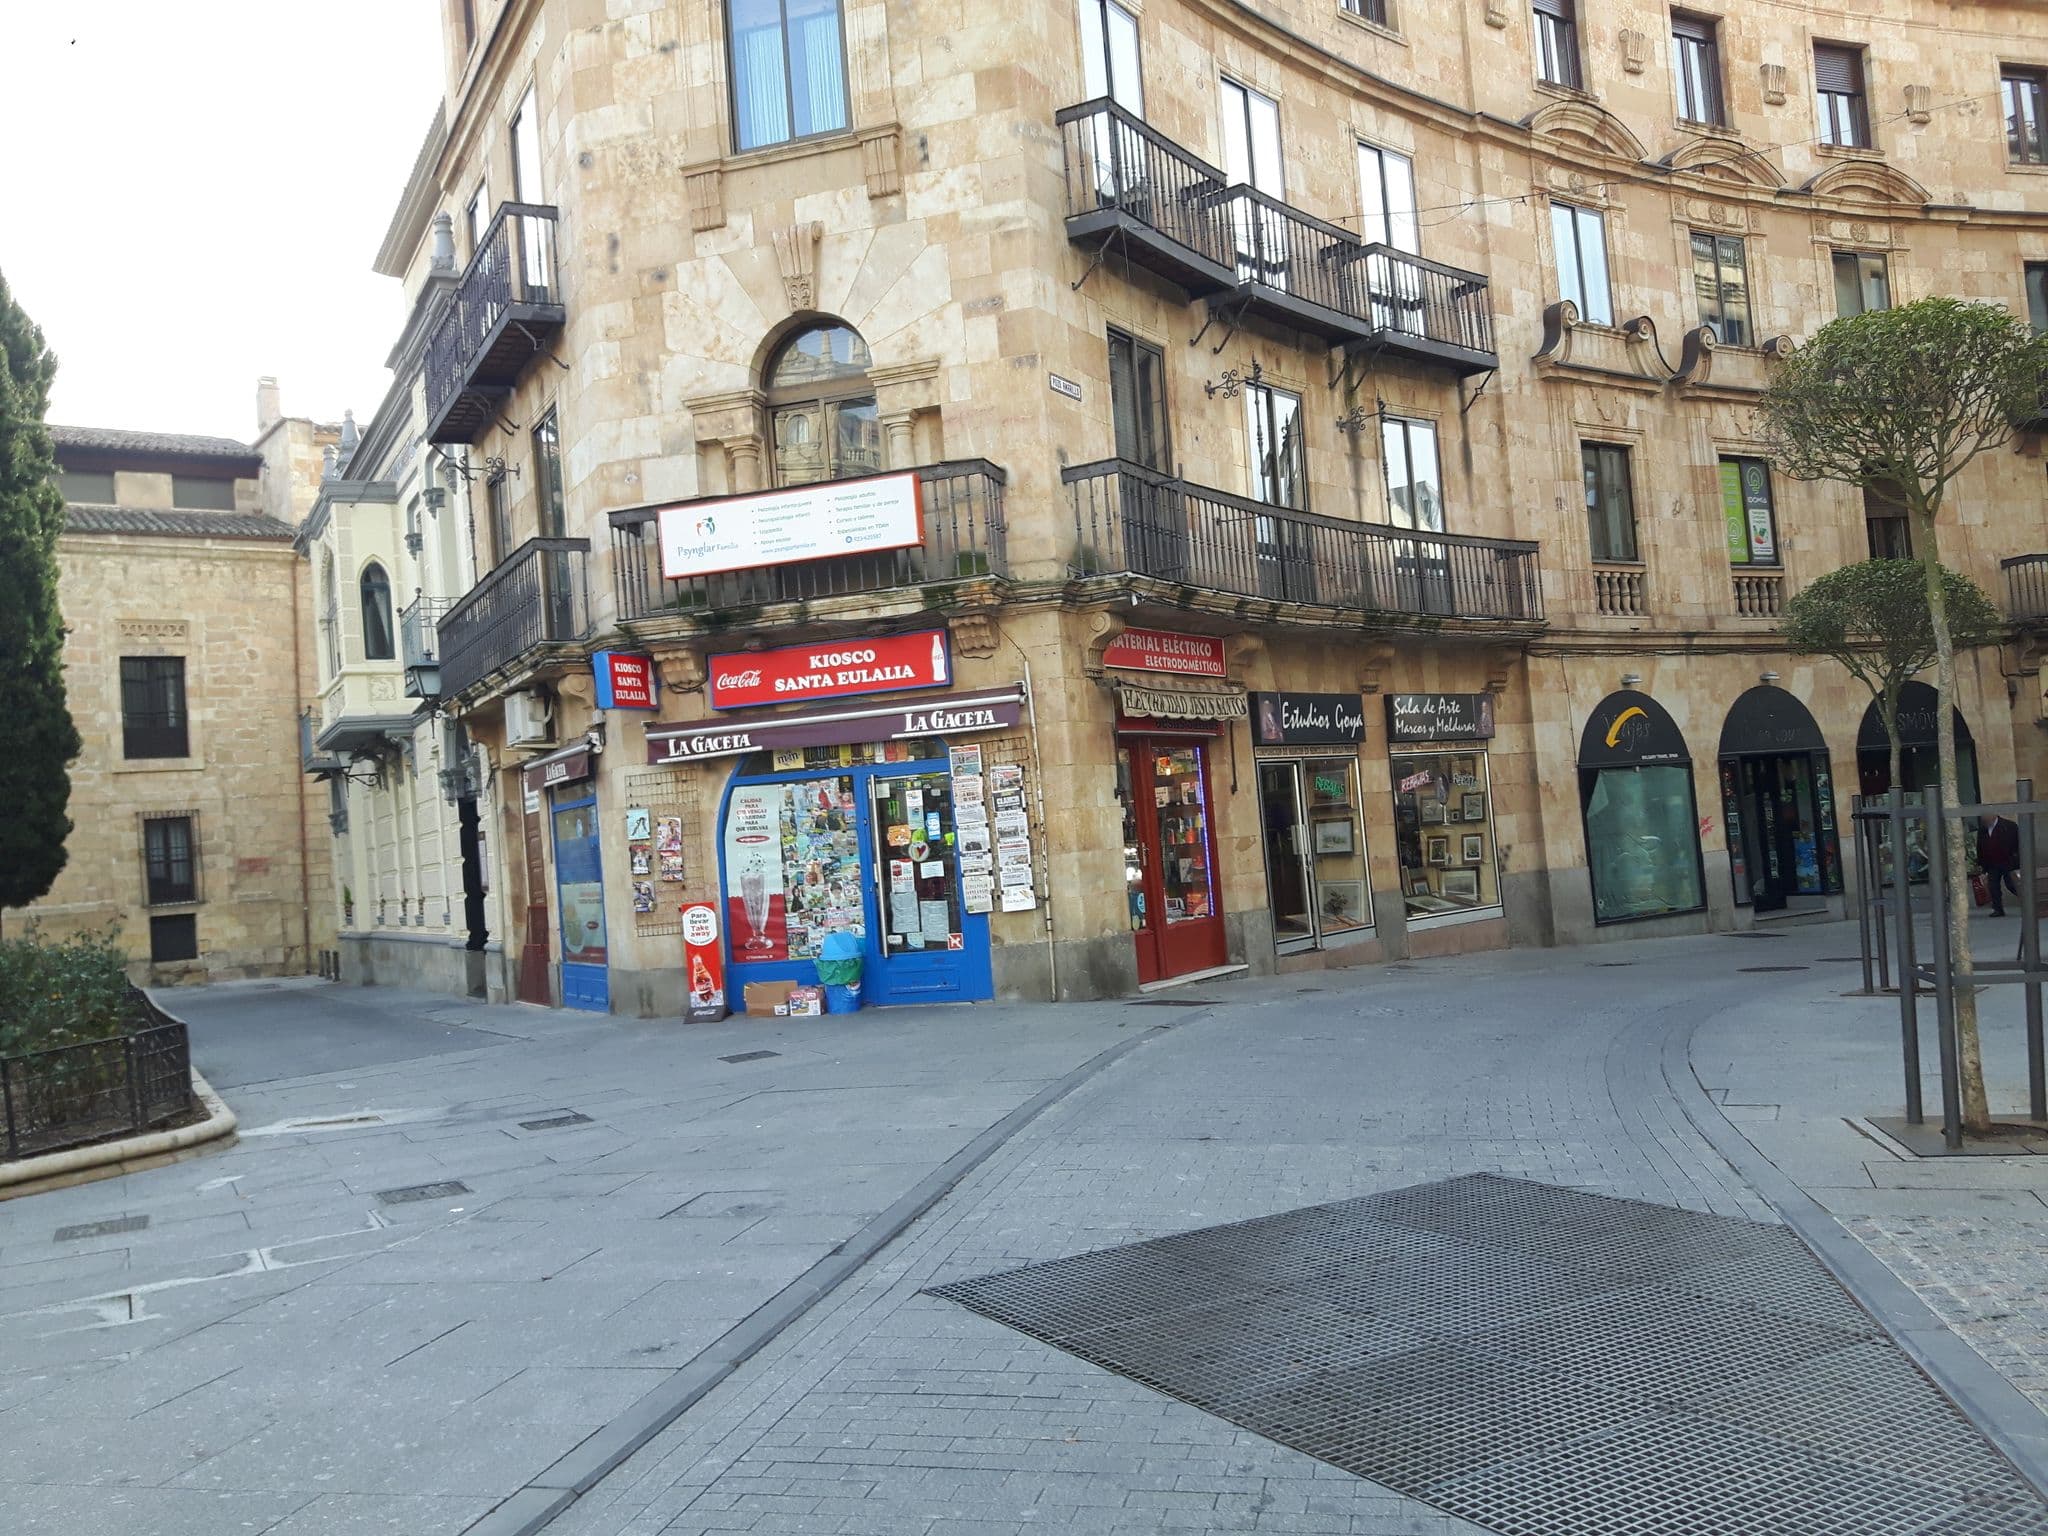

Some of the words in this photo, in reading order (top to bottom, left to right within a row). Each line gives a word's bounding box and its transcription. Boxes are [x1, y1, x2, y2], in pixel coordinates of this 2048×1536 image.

[614, 662, 642, 673] KIOSCO
[810, 650, 876, 669] KIOSCO
[617, 676, 642, 687] SANTA
[717, 669, 762, 690] Coca-Cola
[775, 674, 835, 692] SANTA
[837, 665, 915, 685] EULALIA
[616, 690, 647, 700] EULALIA
[1216, 697, 1247, 715] SANTO
[1394, 697, 1420, 716] Sala
[1423, 697, 1436, 714] de
[1438, 696, 1461, 714] Arte
[904, 713, 928, 732] LA
[930, 710, 995, 729] GACETA
[1282, 702, 1330, 729] Estudios
[1335, 704, 1363, 738] Goya
[1395, 718, 1427, 734] Marcos
[1429, 726, 1435, 739] y
[1436, 716, 1476, 733] Molduras
[668, 738, 690, 756] LA
[691, 734, 751, 753] GACETA
